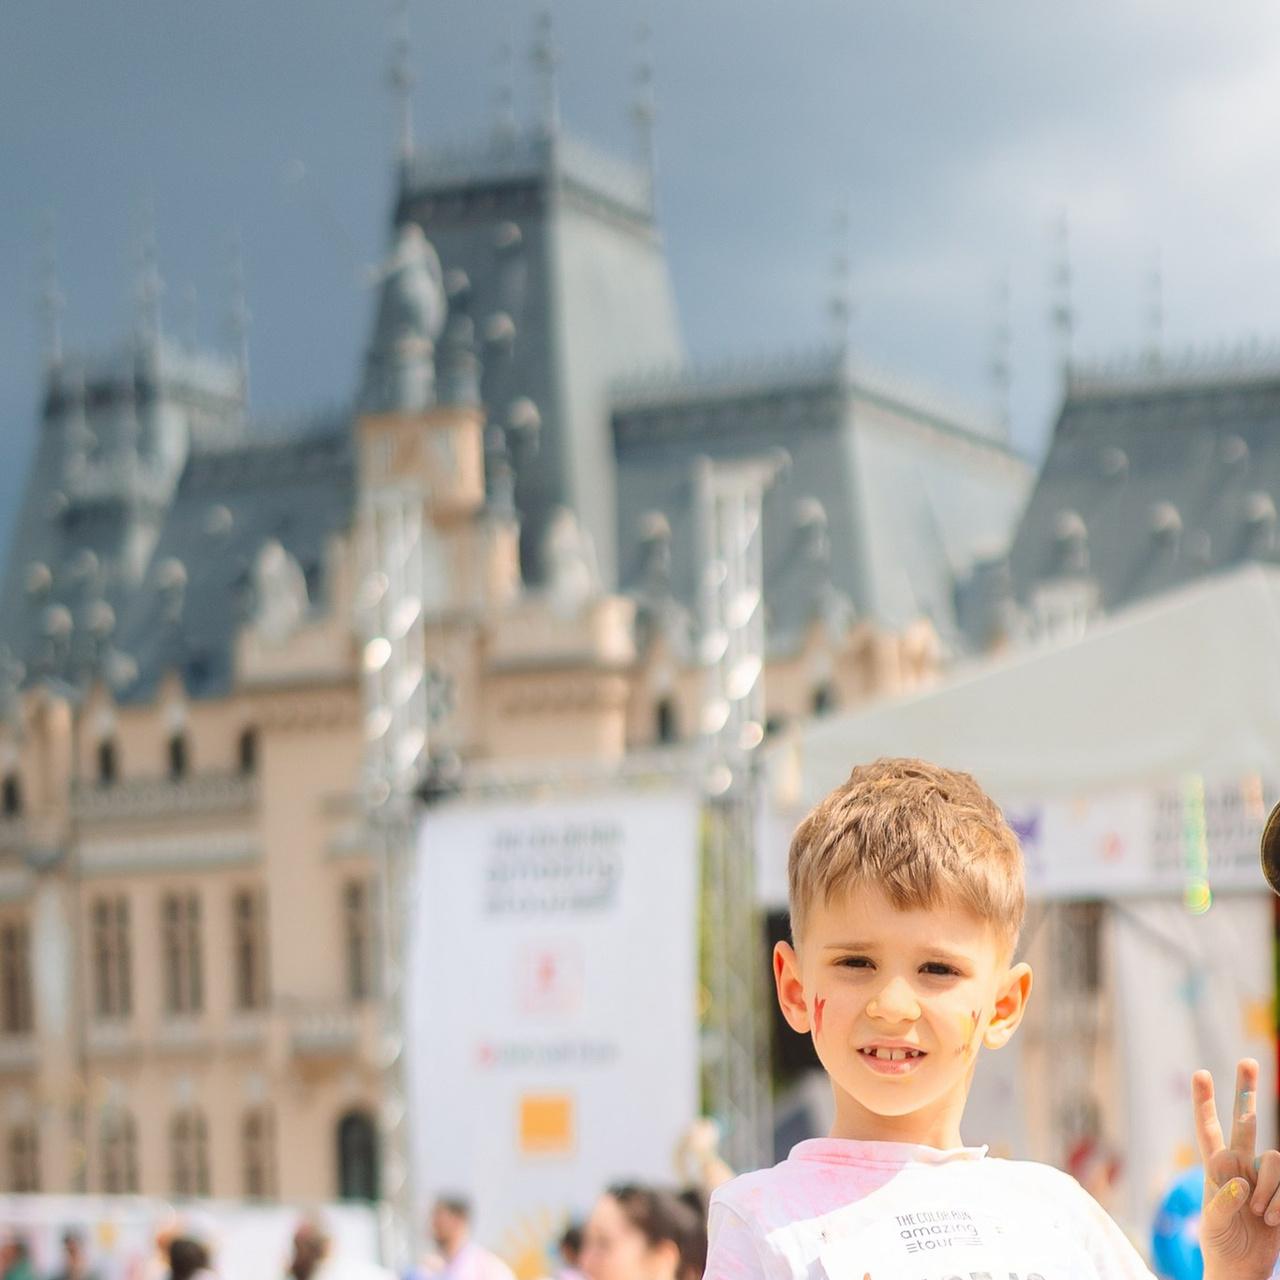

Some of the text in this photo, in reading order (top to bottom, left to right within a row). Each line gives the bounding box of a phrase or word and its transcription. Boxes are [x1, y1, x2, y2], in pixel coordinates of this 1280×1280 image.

[895, 1213, 917, 1227] THE
[900, 1223, 978, 1240] amazing
[916, 1237, 953, 1251] tour
